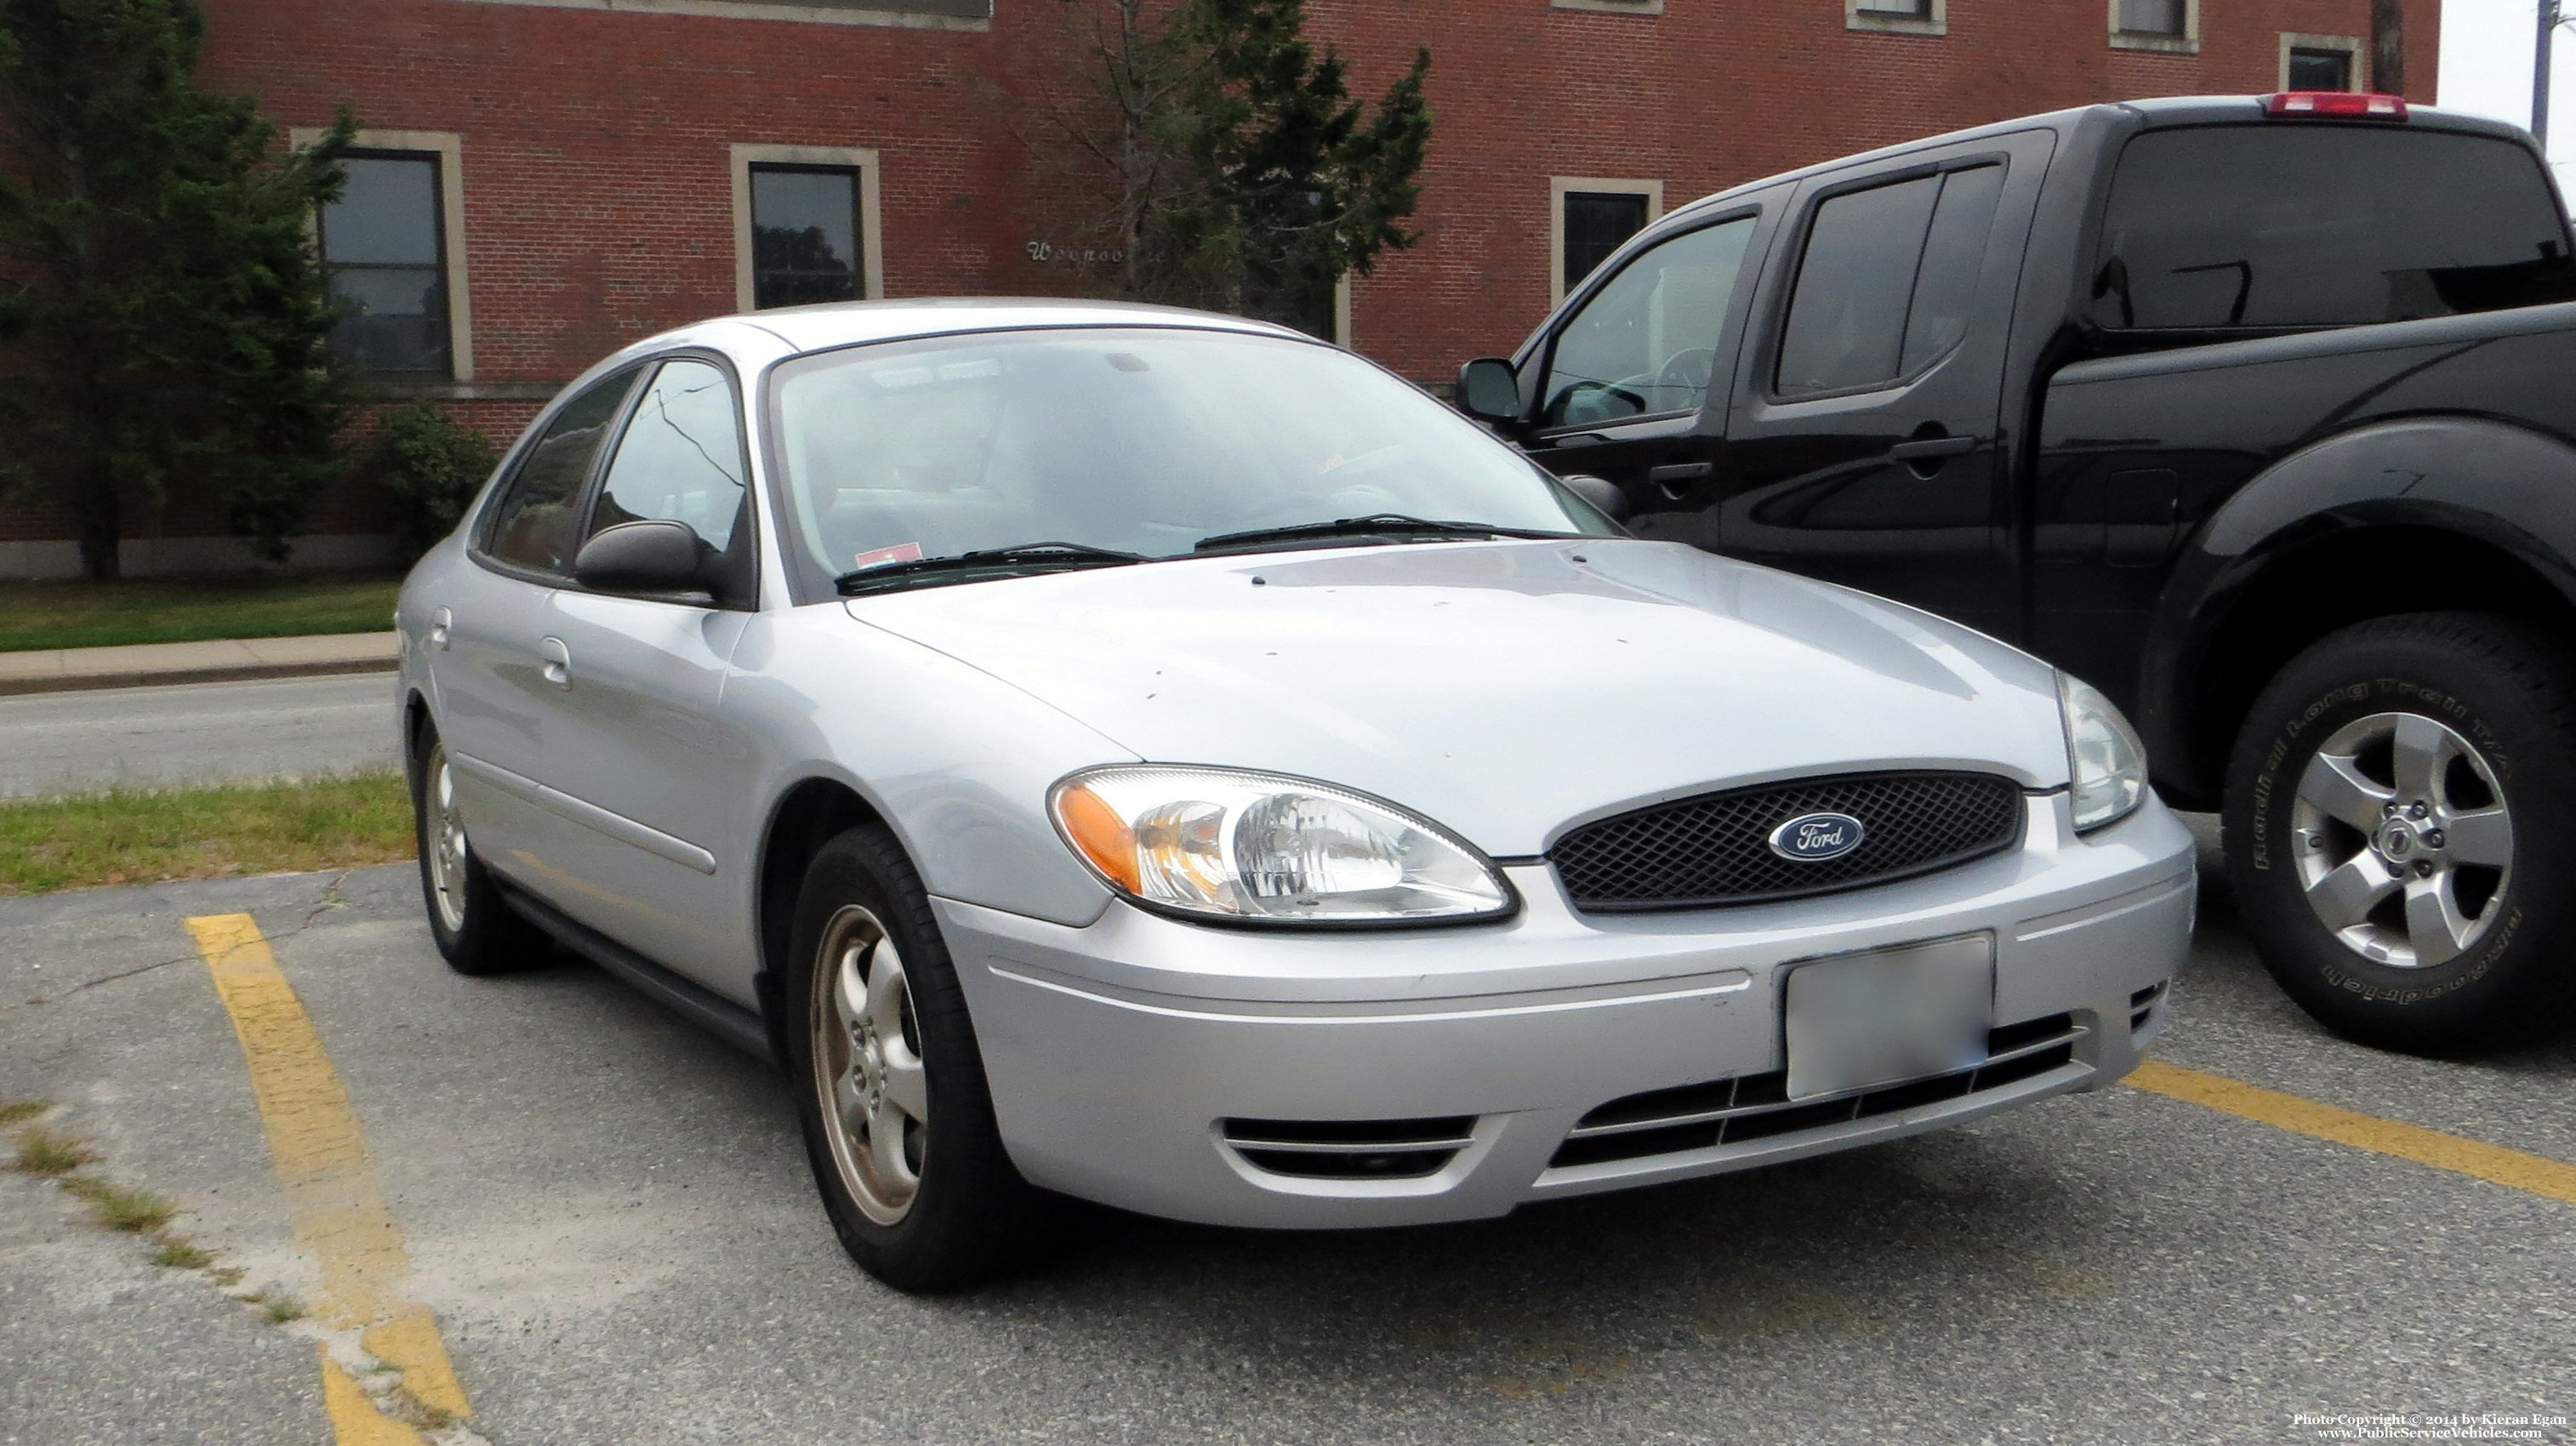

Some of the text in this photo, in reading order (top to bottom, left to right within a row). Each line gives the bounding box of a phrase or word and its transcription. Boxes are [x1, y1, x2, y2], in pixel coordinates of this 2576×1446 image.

[2287, 683, 2368, 734] Long
[2377, 678, 2468, 719] Trail
[1797, 823, 1844, 850] Ford
